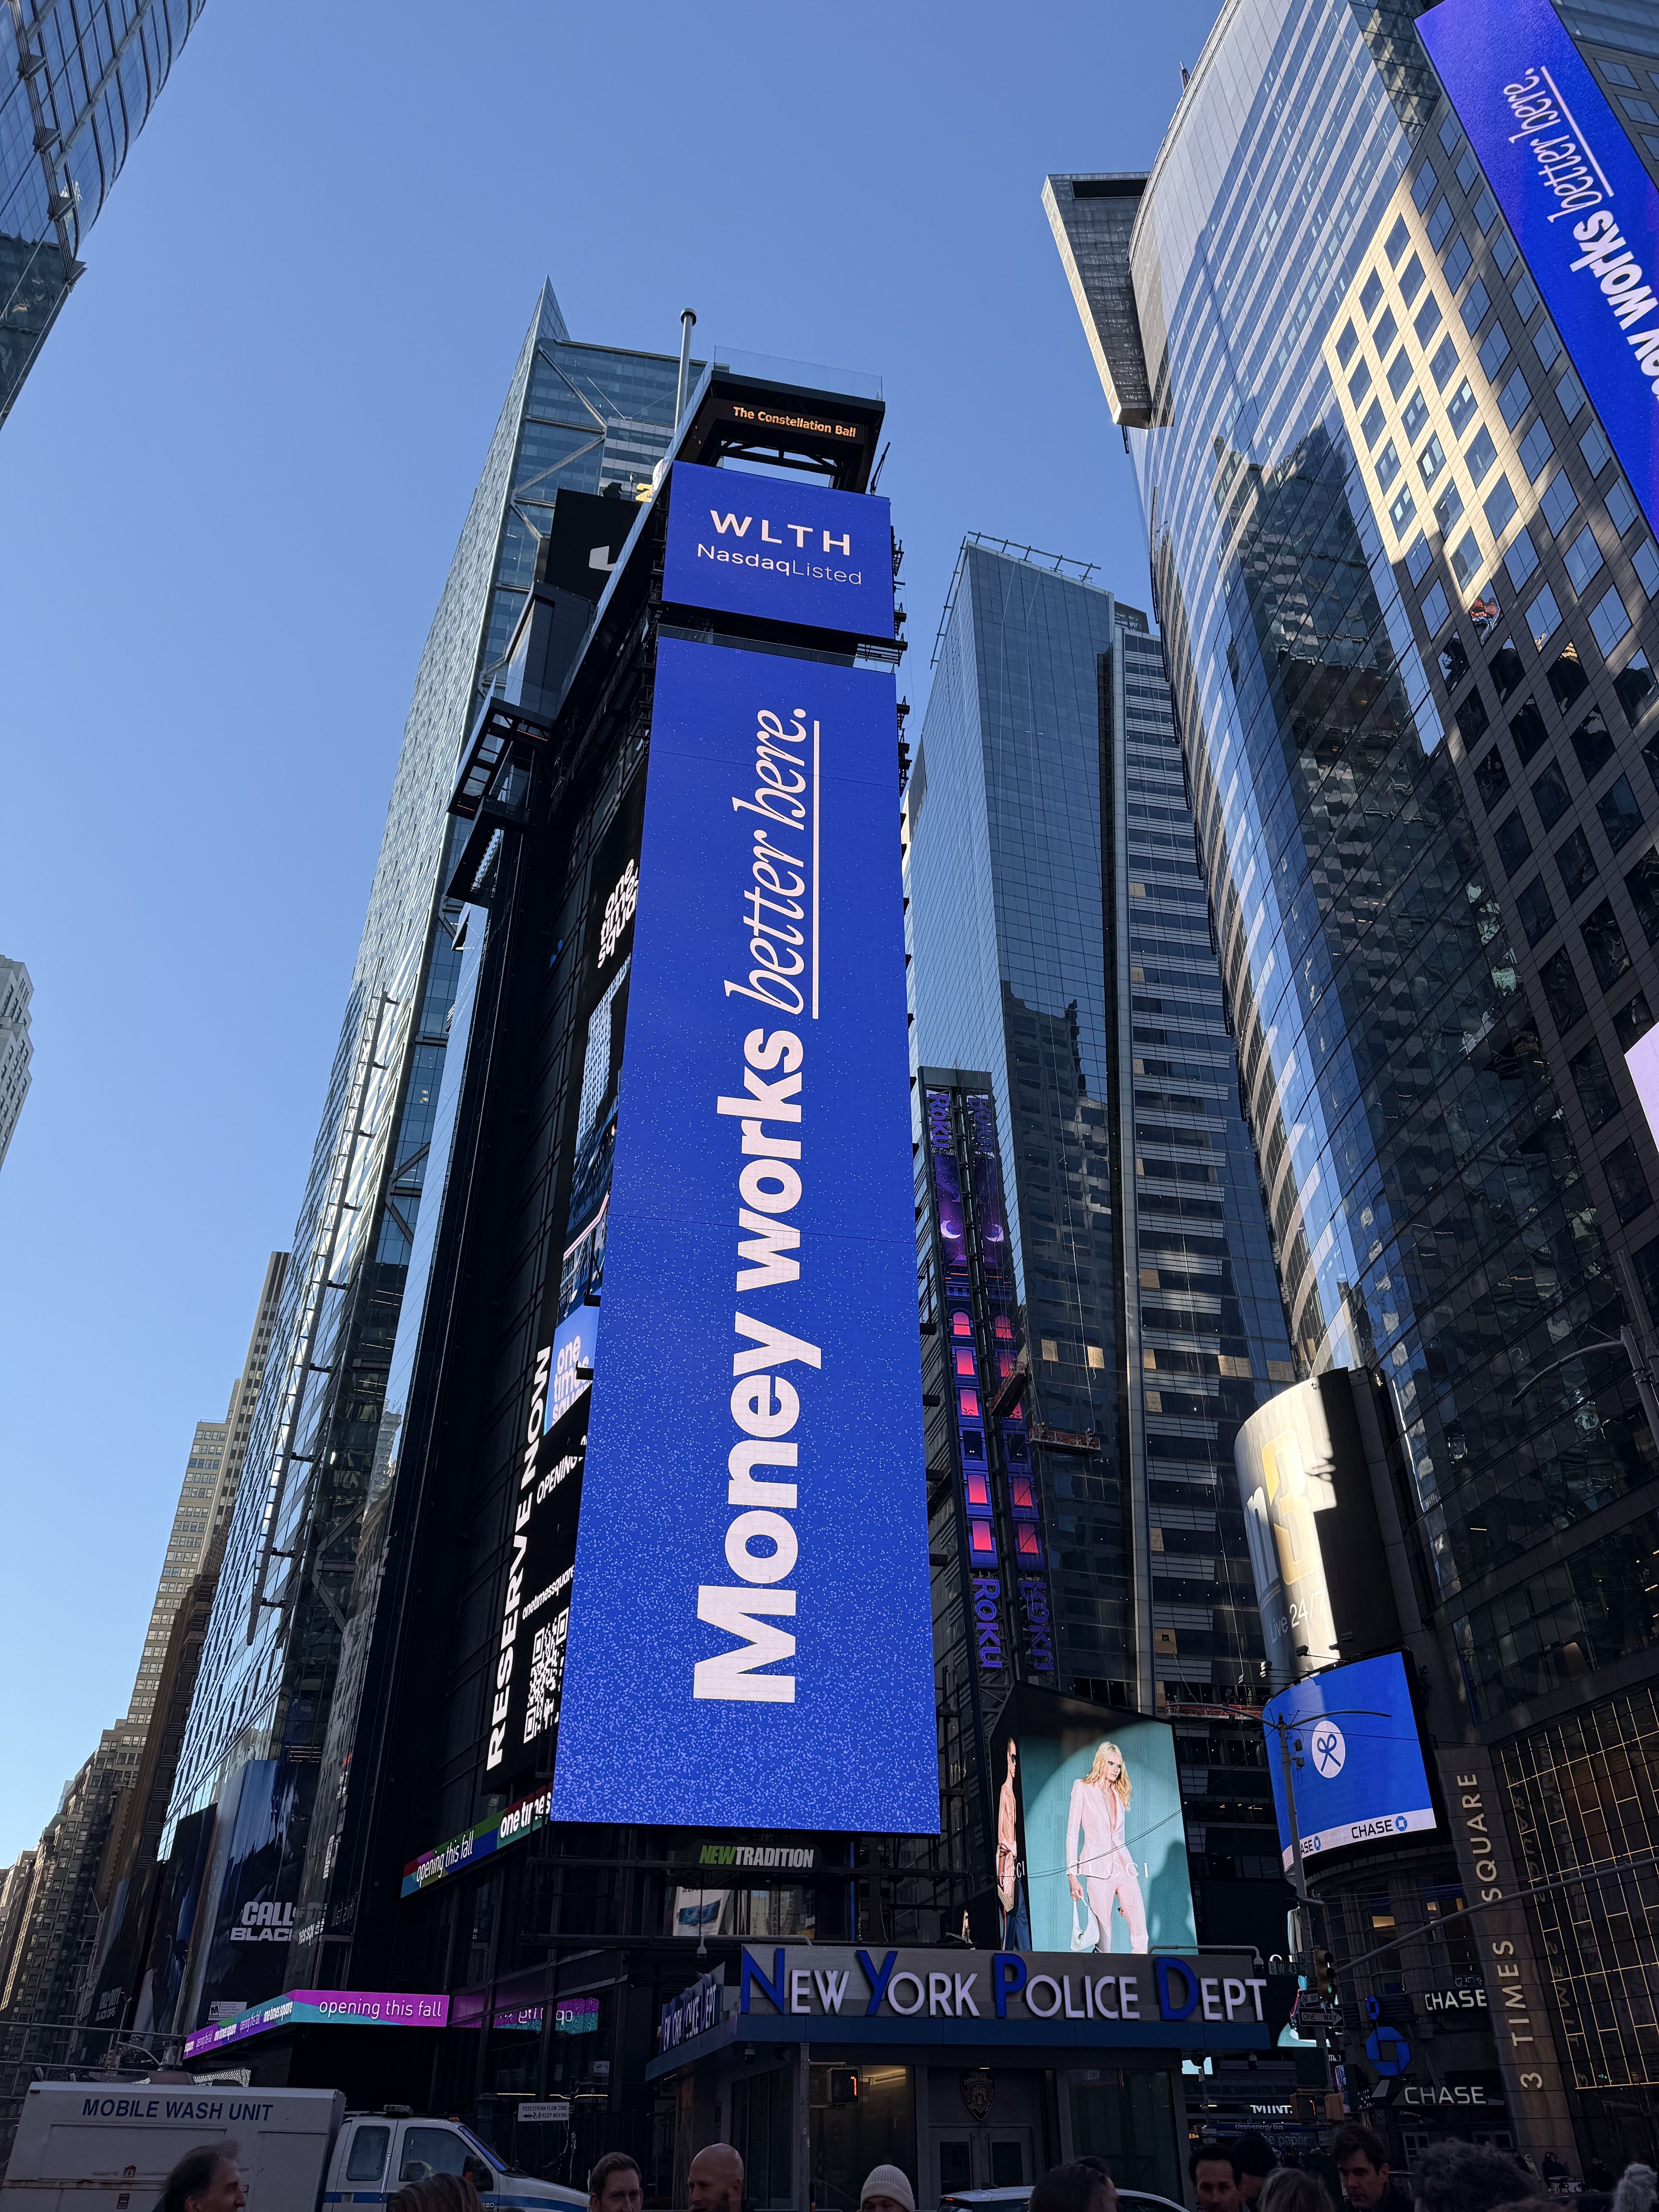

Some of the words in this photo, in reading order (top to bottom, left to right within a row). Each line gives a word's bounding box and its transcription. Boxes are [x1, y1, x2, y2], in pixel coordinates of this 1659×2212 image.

[1530, 135, 1602, 223] better
[733, 406, 754, 419] The
[758, 411, 831, 433] Constellation
[835, 425, 856, 437] Ball
[710, 509, 851, 556] WLTH
[697, 543, 862, 585] NasdaqListed
[732, 708, 807, 830] here.
[605, 859, 634, 919] one
[598, 885, 639, 969] squa
[724, 830, 805, 1015] better
[929, 1094, 950, 1149] ROKU
[717, 1028, 803, 1292] works
[557, 1335, 580, 1375] one
[693, 1311, 821, 1703] Money
[486, 1492, 532, 1771] RESERVE
[520, 1346, 551, 1491] NOW
[972, 1578, 1002, 1668] ROKU
[1269, 1615, 1288, 1644] Live
[1289, 1590, 1326, 1628] 24/7
[500, 1810, 520, 1838] one
[1352, 1819, 1394, 1839] CHASE
[1457, 1774, 1503, 1902] SQUARE
[416, 1850, 445, 1888] opening
[445, 1839, 460, 1867] this
[460, 1829, 474, 1860] fall
[1069, 1860, 1149, 1878] GUCCI
[230, 1927, 293, 1941] BLAC
[241, 1901, 294, 1926] CALL
[740, 1945, 851, 2015] NEW
[856, 1950, 980, 2017] YORK
[993, 1953, 1140, 2020] POLICE
[1156, 1957, 1267, 2021] DEPT
[1278, 1963, 1285, 1974] W
[1288, 1963, 1297, 1974] 43
[211, 2006, 219, 2014] M
[319, 1999, 380, 2020] opening
[386, 1999, 414, 2016] this
[418, 2001, 441, 2018] fall
[1425, 1989, 1487, 2011] CHASE
[1492, 1941, 1534, 2047] TIMES
[1405, 2086, 1487, 2105] CHASE
[1520, 2073, 1542, 2088] 3
[82, 2099, 160, 2118] MOBILE
[165, 2102, 223, 2121] WASH
[228, 2103, 274, 2121] UNIT
[1278, 2135, 1308, 2147] paper
